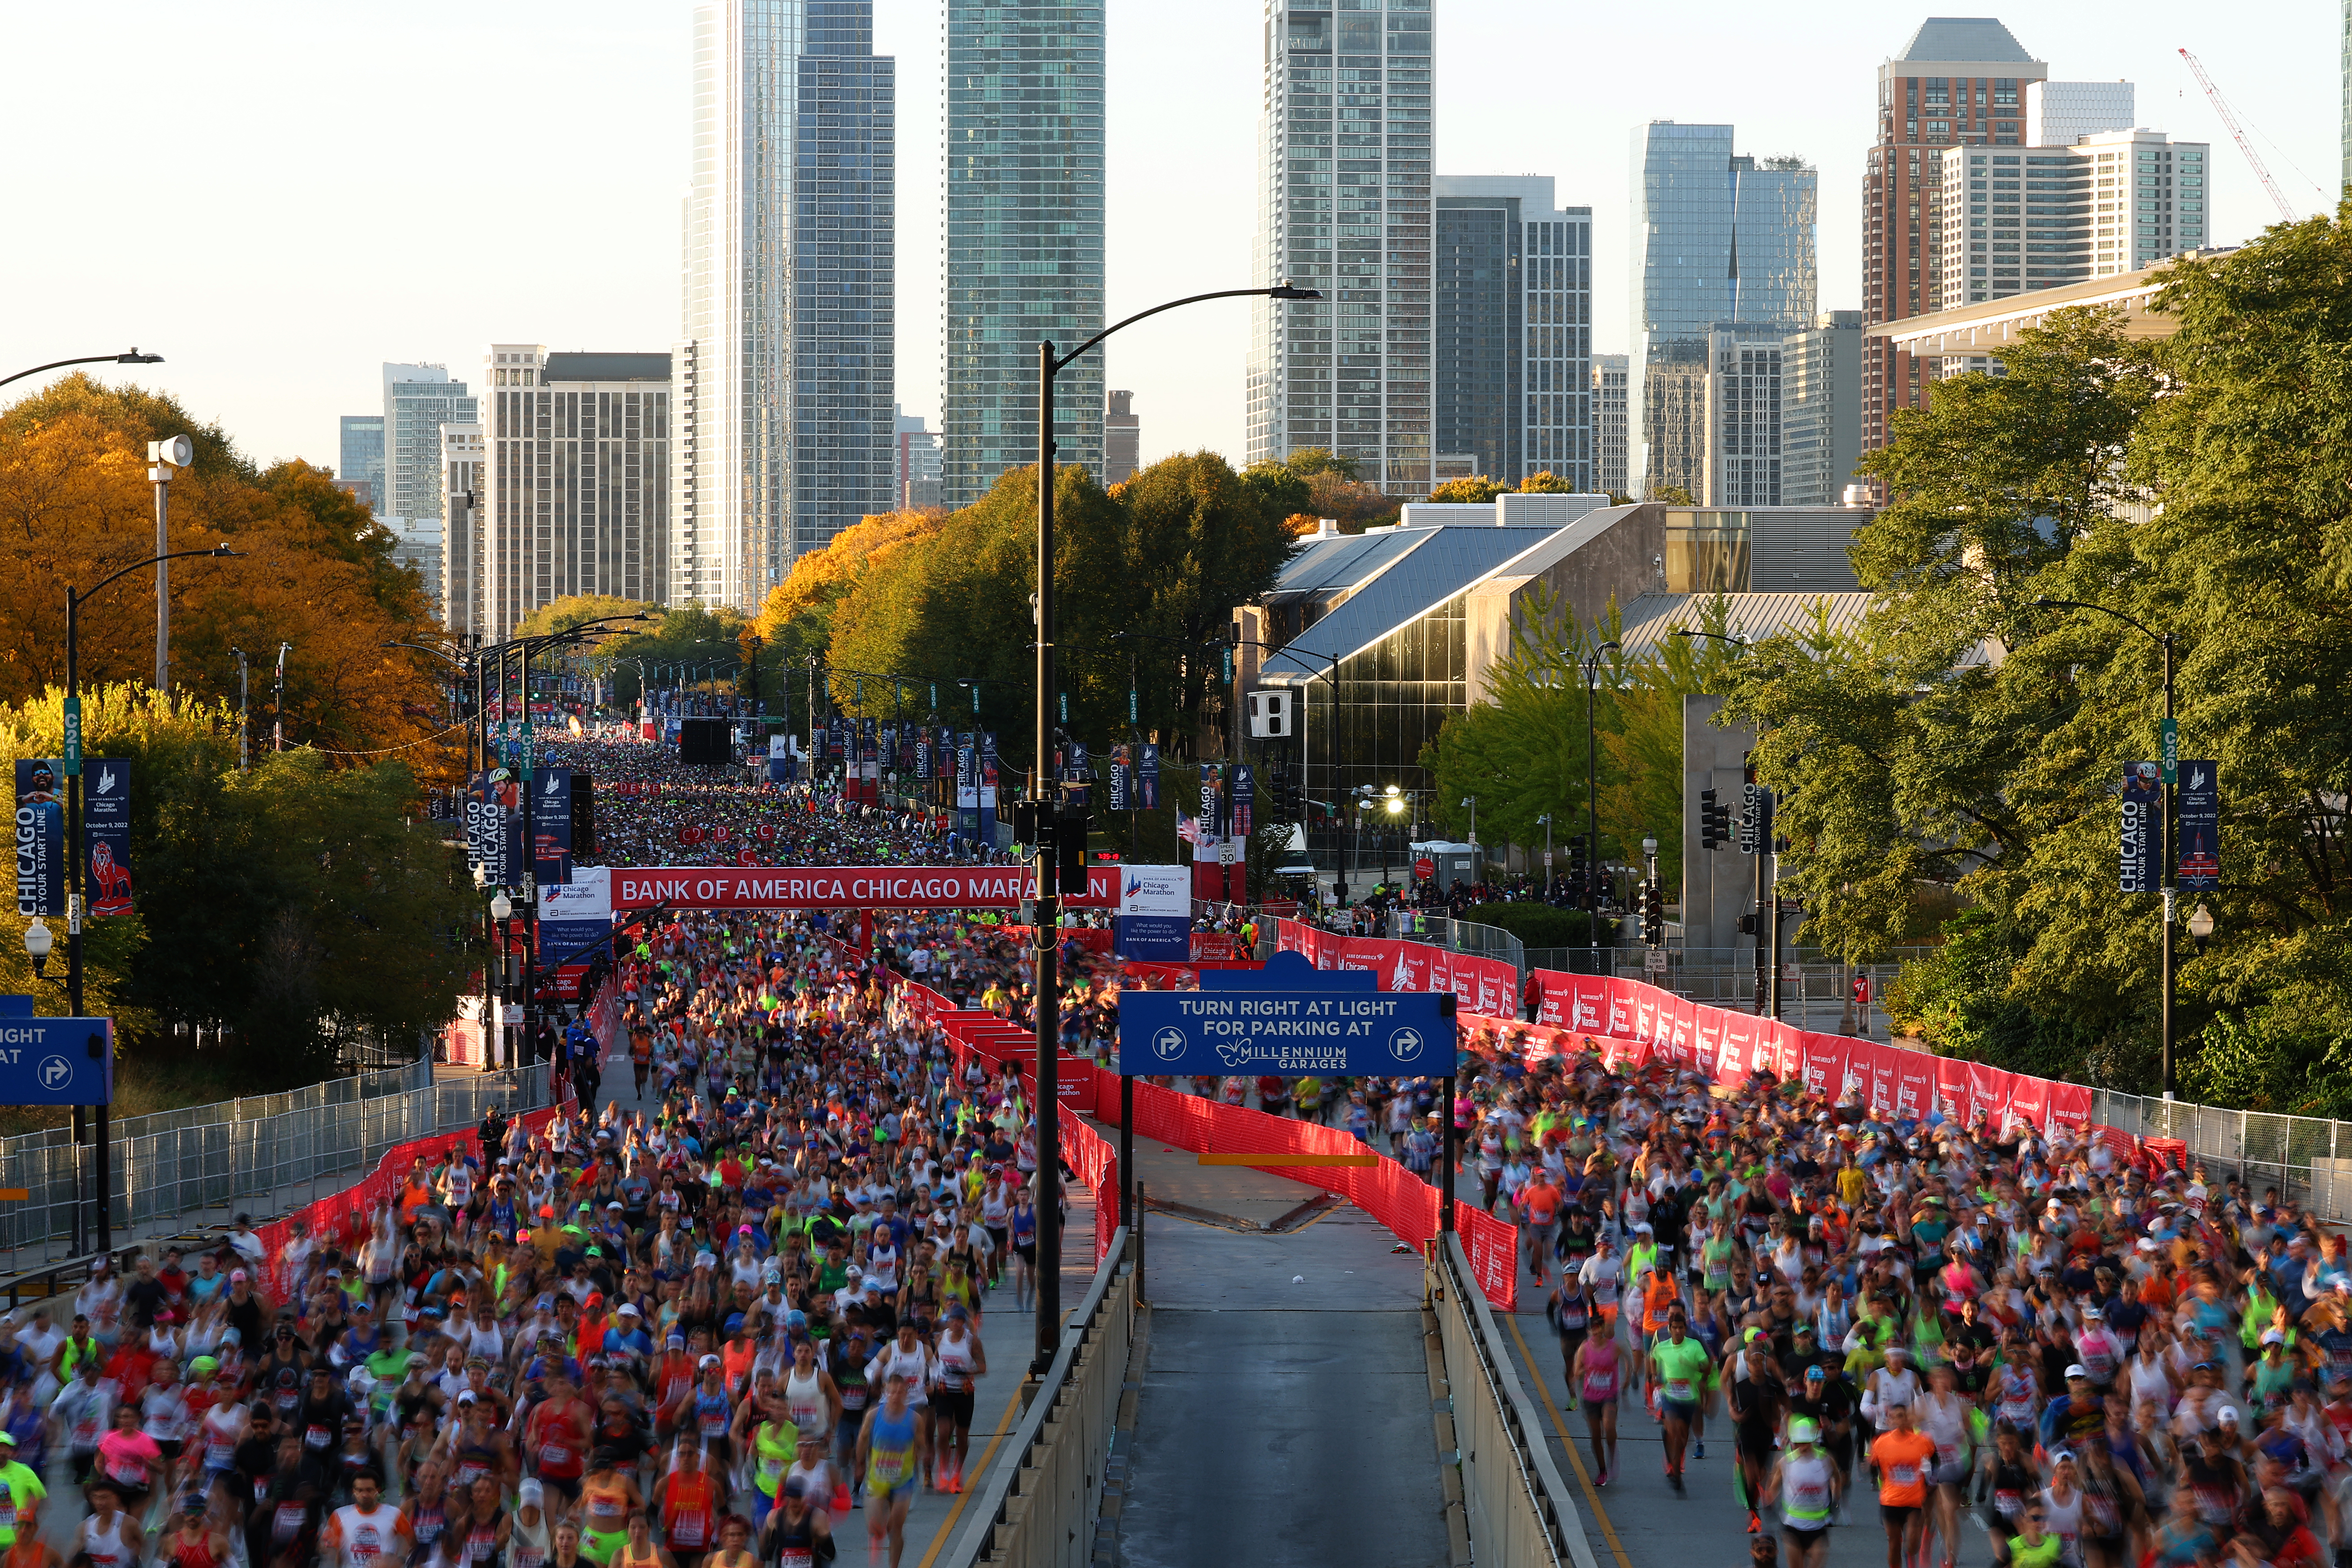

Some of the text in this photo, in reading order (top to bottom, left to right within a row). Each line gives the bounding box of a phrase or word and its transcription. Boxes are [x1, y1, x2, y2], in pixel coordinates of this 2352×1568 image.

[65, 713, 78, 759] C21
[499, 732, 508, 762] C41
[522, 734, 532, 769] C31
[2165, 732, 2176, 771] C20
[958, 750, 966, 788] CHICAGO
[1110, 764, 1119, 810] CHICAGO
[1200, 786, 1210, 836] CHICAGO
[1740, 783, 1755, 854] CHICAGO
[467, 801, 481, 871] CHICAGO
[682, 830, 690, 840] C
[718, 827, 726, 837] D
[760, 825, 769, 836] C
[484, 803, 499, 885] CHICAGO
[2120, 801, 2138, 892] CHICAGO
[16, 808, 37, 916] CHICAGO
[37, 809, 47, 915] IS YOUR START LINE
[741, 851, 750, 862] C
[622, 880, 690, 900] BANK
[697, 879, 730, 900] OF
[734, 879, 846, 900] AMERICA
[853, 878, 960, 900] CHICAGO
[70, 897, 78, 931] C21
[1204, 947, 1226, 955] Chicago
[1346, 961, 1368, 970] Chicago
[1179, 1001, 1397, 1016] TURN RIGHT AT LIGHT
[1544, 998, 1559, 1012] Chicago
[1581, 1003, 1596, 1017] Chicago
[1543, 1012, 1562, 1023] Marathon
[1581, 1016, 1600, 1028] Marathon
[0, 1029, 46, 1043] IGHT
[1204, 1021, 1373, 1036] FOR PARKING AT
[1495, 1025, 1508, 1051] 5
[0, 1049, 22, 1064] AT
[1240, 1047, 1346, 1057] MILLENNIUM
[1278, 1059, 1346, 1069] GARAGES
[1810, 1066, 1825, 1082] Chicago
